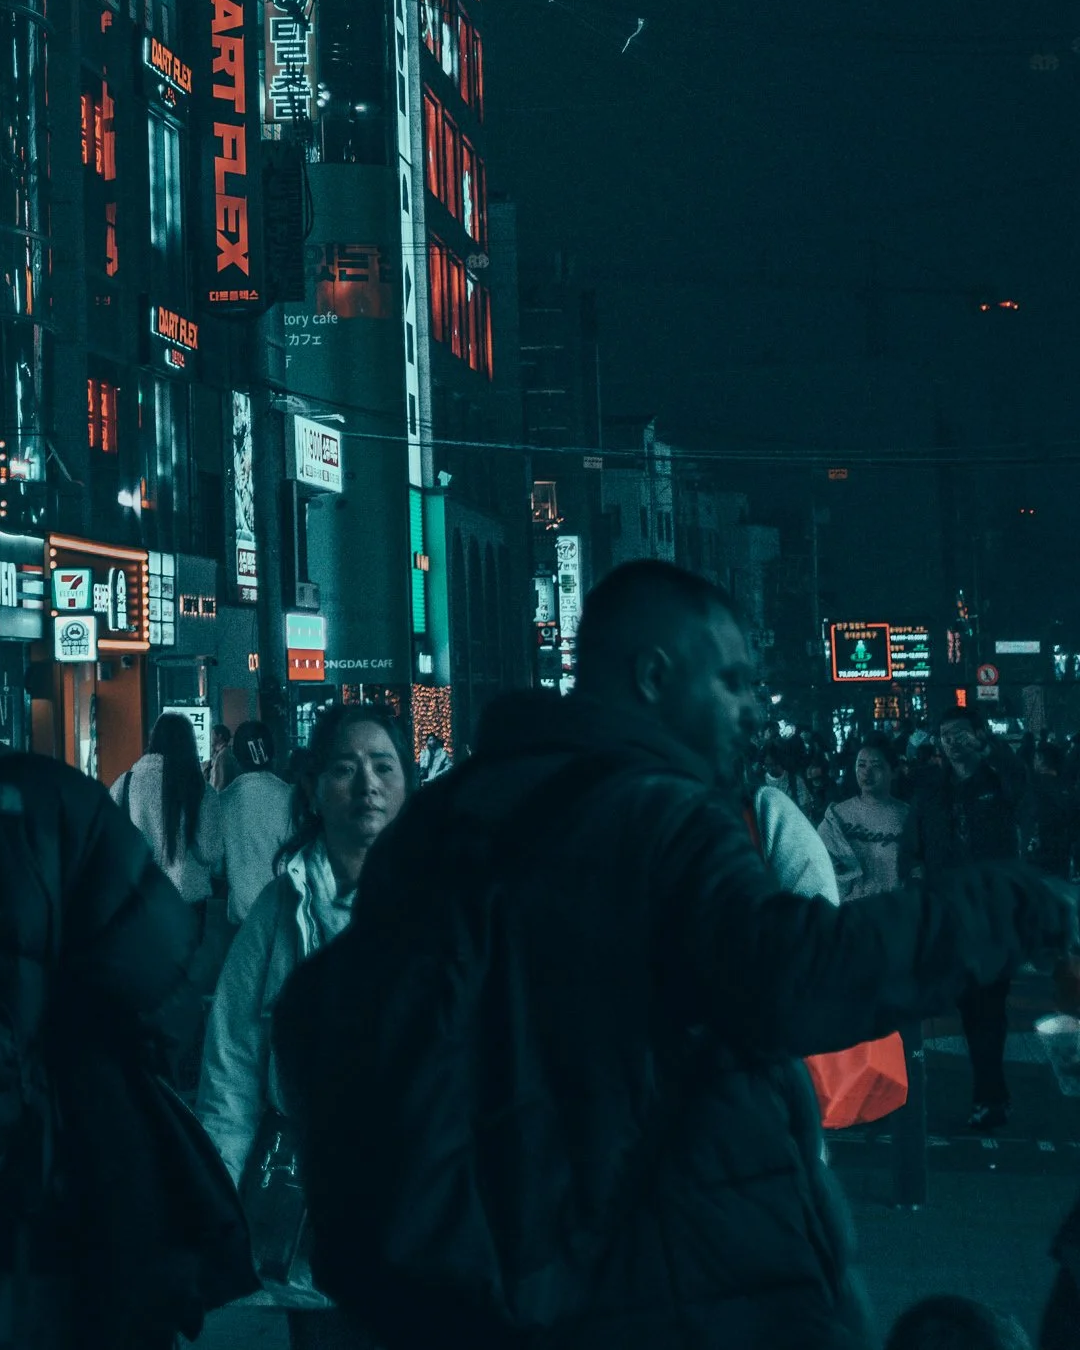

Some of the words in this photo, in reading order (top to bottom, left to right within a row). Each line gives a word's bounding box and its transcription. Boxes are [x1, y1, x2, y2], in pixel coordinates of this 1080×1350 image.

[152, 37, 173, 76] DART
[173, 56, 192, 93] FLEX
[213, 122, 248, 277] FLEX
[209, 290, 258, 302] 다트플렉스
[312, 311, 338, 324] cafe
[158, 306, 179, 341] DART
[179, 317, 198, 349] FLEX
[285, 333, 322, 346] カフェ
[371, 658, 393, 668] CAFE
